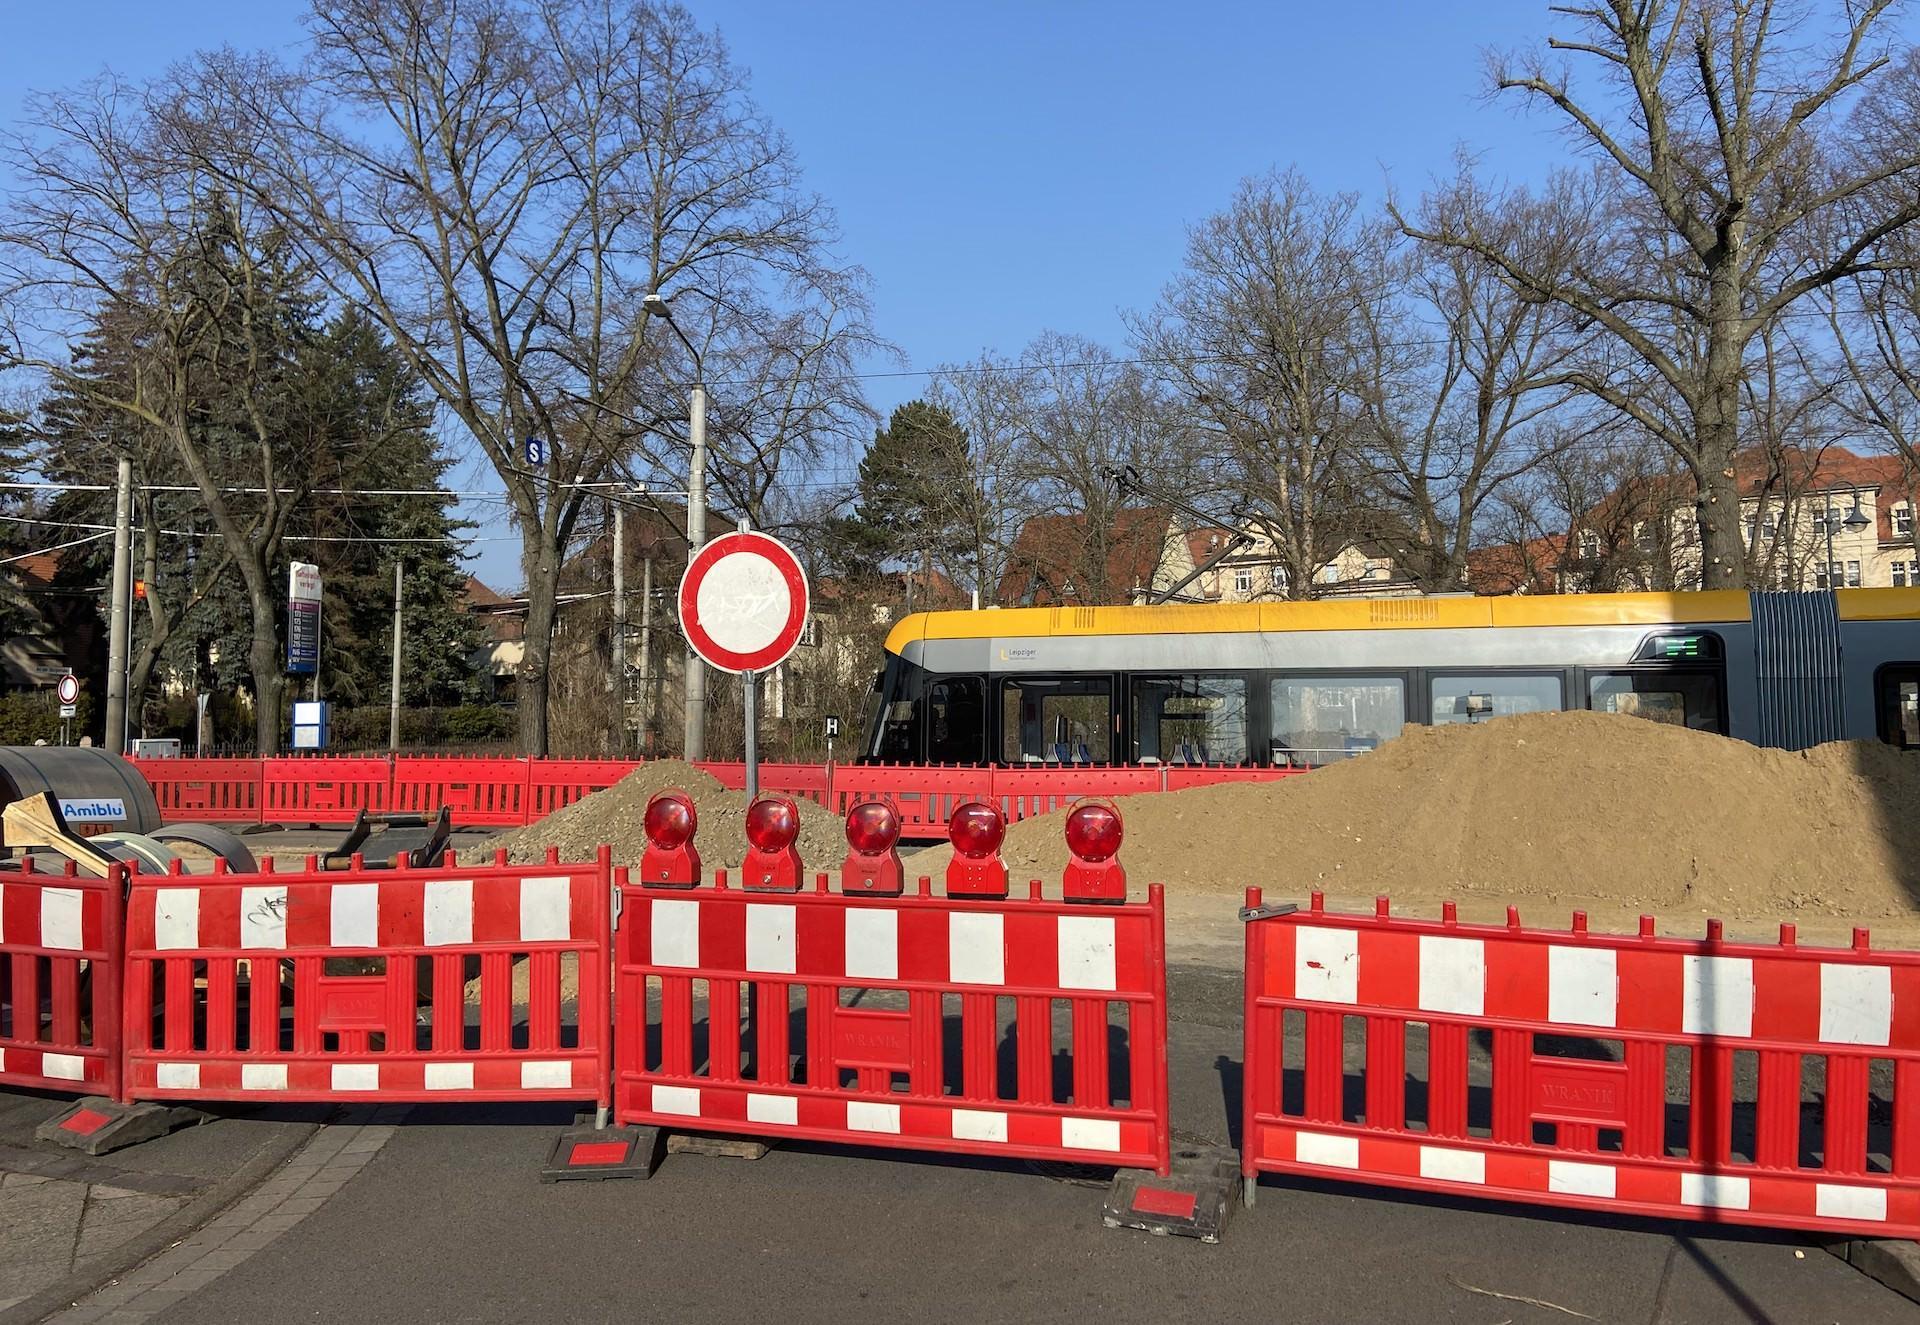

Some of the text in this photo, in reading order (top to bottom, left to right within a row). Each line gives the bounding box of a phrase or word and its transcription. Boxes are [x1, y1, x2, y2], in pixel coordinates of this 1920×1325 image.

[529, 442, 539, 462] S
[1009, 648, 1036, 656] Leipziger
[827, 718, 838, 734] H
[64, 803, 122, 816] Amiblu
[1541, 1083, 1613, 1104] WRANIK
